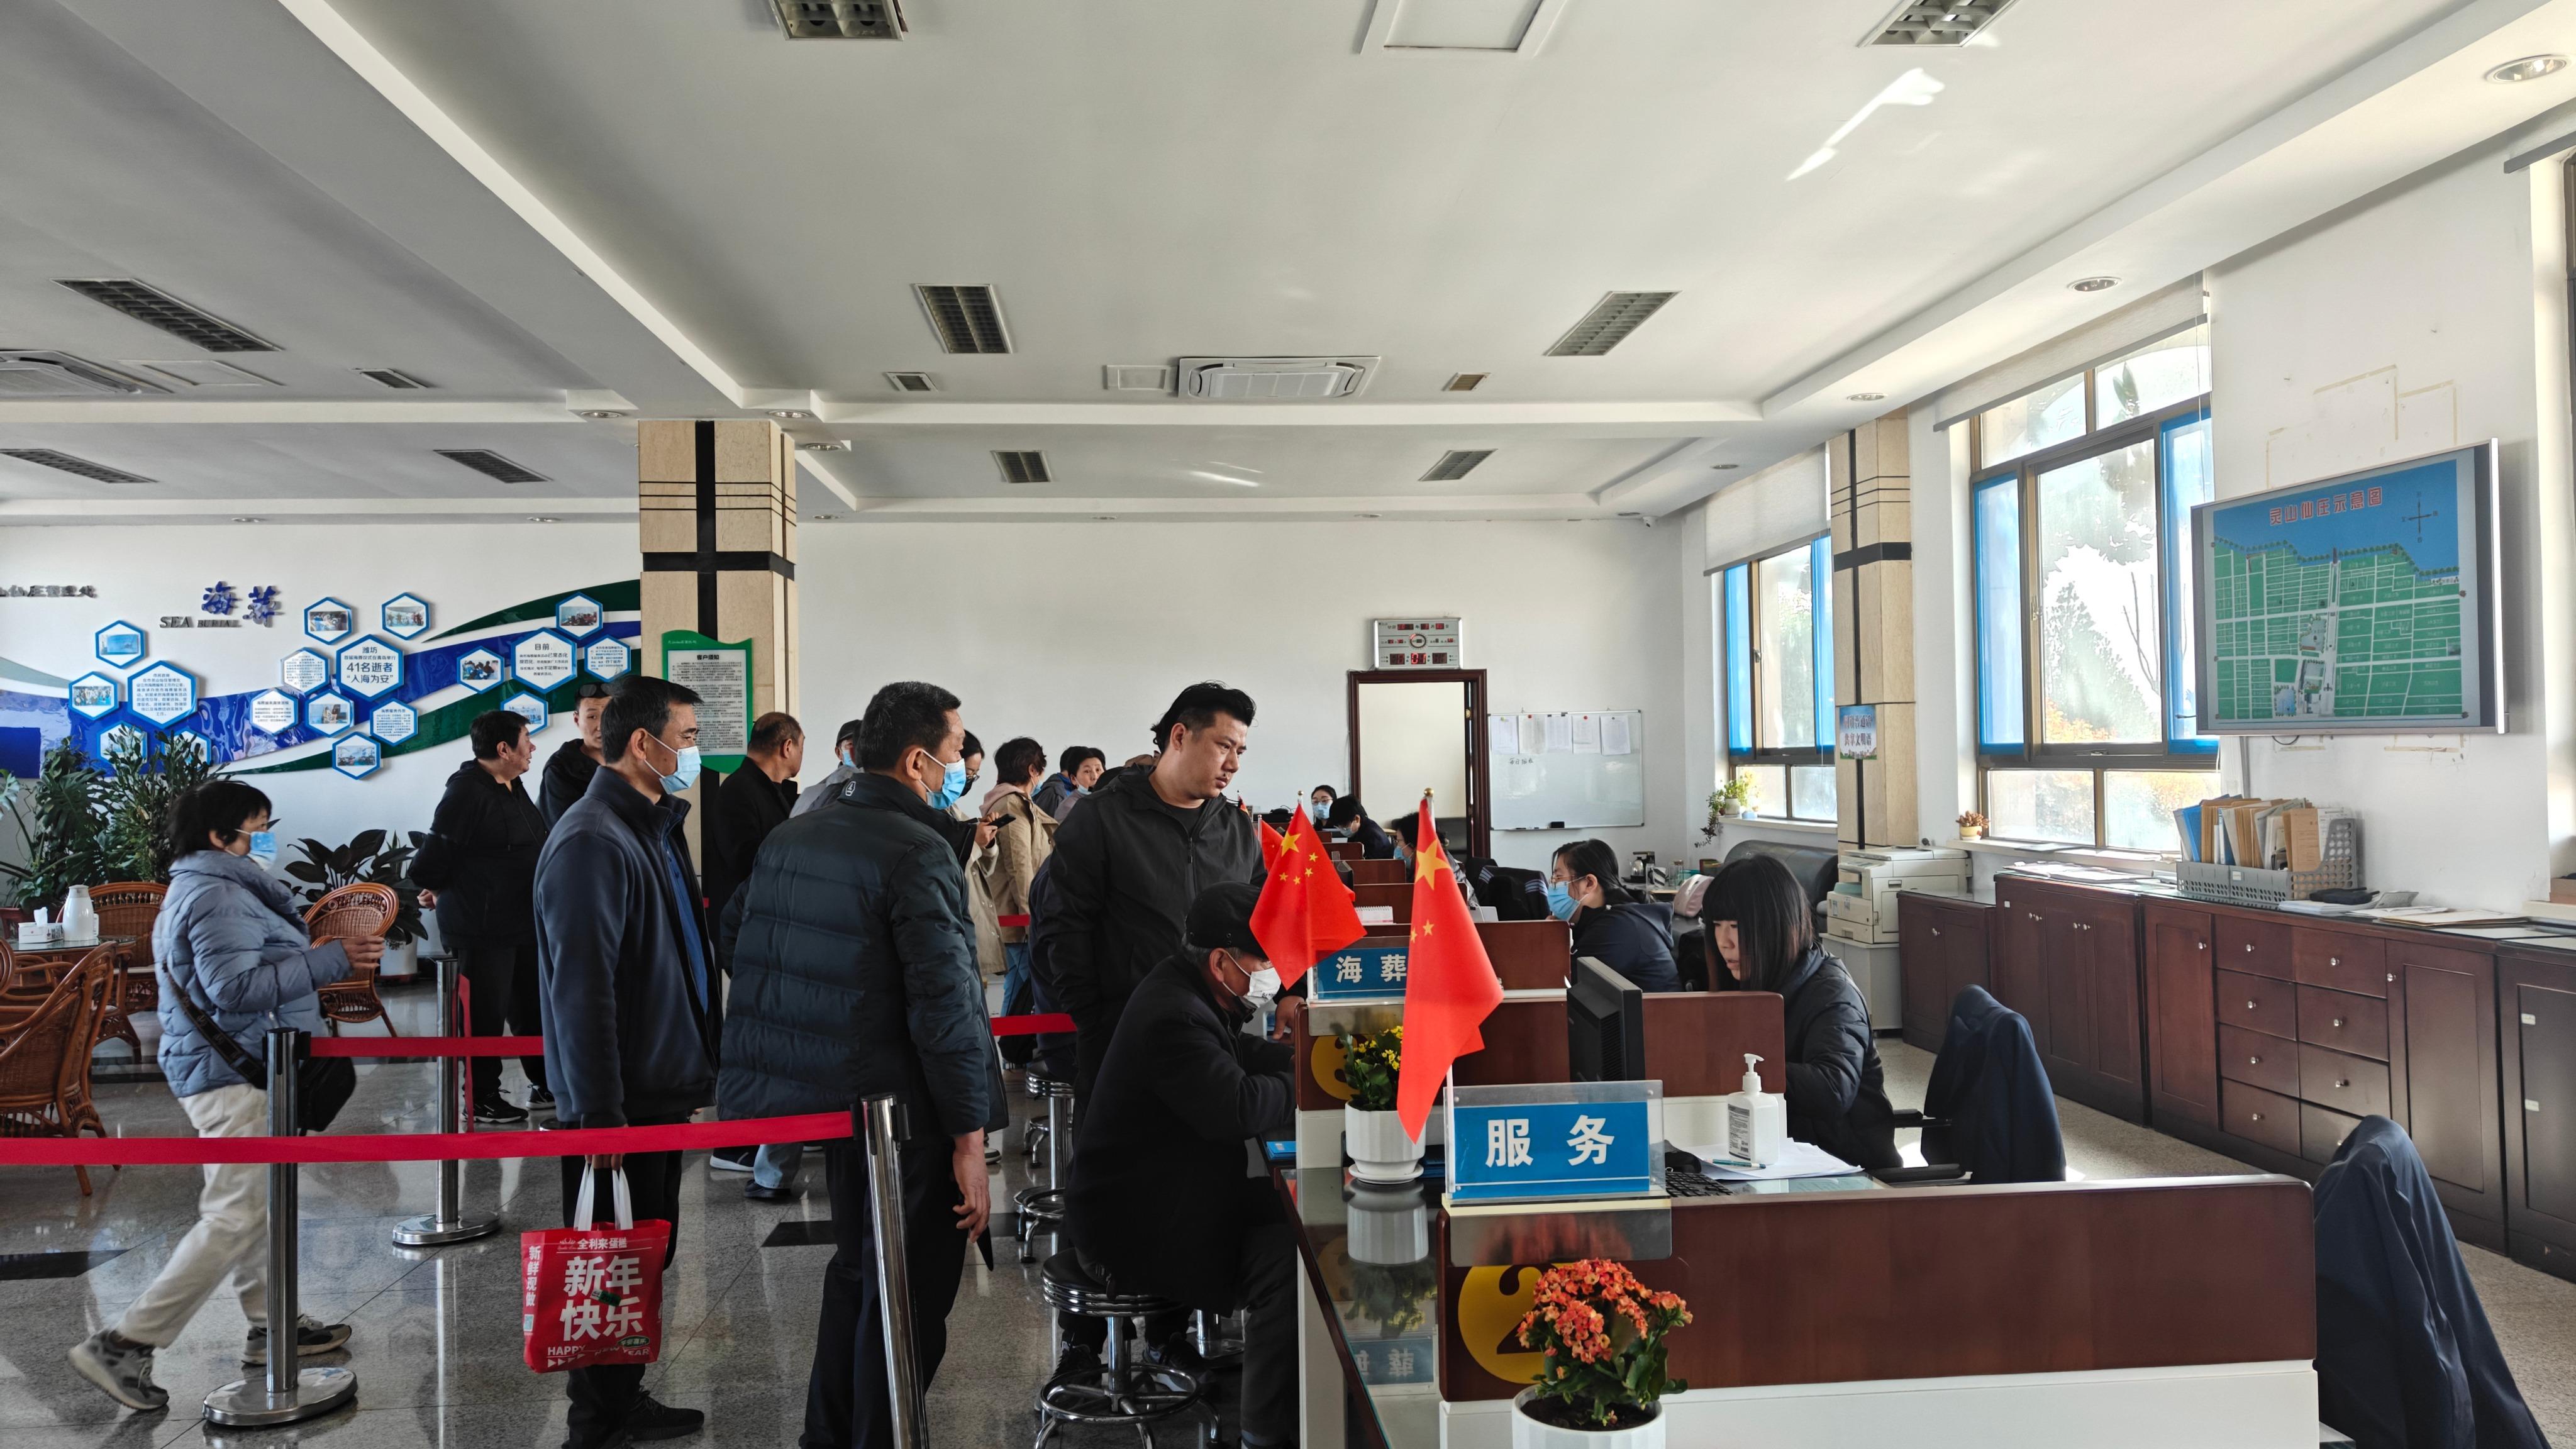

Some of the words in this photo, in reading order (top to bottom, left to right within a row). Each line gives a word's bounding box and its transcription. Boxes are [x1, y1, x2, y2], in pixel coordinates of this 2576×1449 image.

[2269, 486, 2384, 526] 灵山仙庄示意图
[160, 616, 192, 628] SEA
[201, 581, 277, 627] 海葬
[347, 662, 393, 672] 41名逝者
[1336, 955, 1407, 983] 海葬
[1485, 1114, 1614, 1168] 服务
[577, 1237, 628, 1250] 全利来蛋糕
[526, 1245, 541, 1307] 新鲜现做
[564, 1255, 643, 1297] 新年
[560, 1296, 643, 1342] 快乐
[547, 1345, 586, 1356] HAPPY
